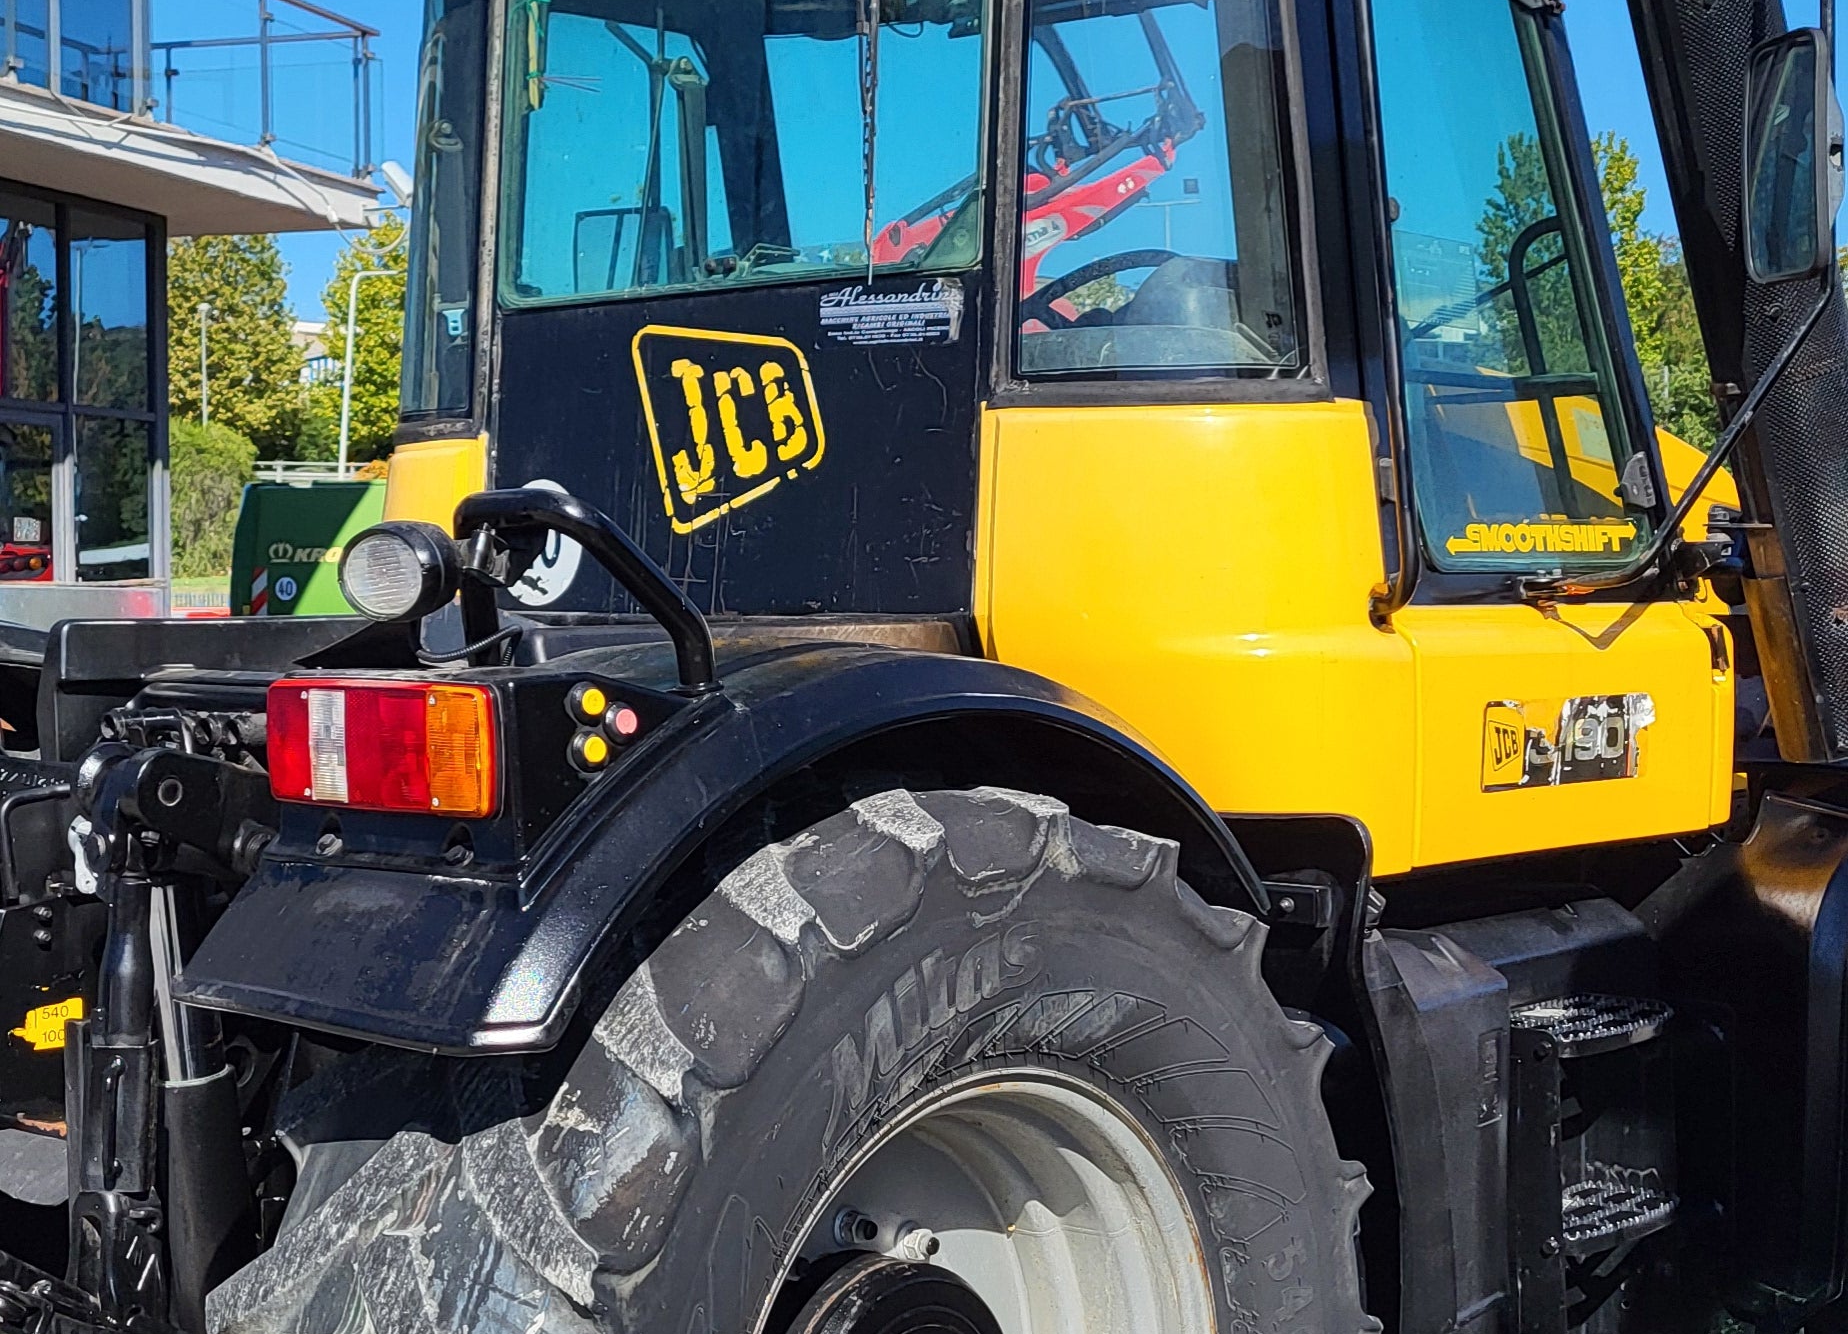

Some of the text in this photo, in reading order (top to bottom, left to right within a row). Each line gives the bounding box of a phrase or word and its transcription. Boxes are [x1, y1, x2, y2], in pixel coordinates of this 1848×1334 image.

[820, 282, 955, 306] Alessandrin
[860, 314, 897, 322] AGRICOLE
[671, 359, 807, 504] JCB
[1466, 523, 1626, 553] SMOOTHSHIFT
[293, 547, 343, 563] KRO
[278, 580, 294, 597] 40
[1493, 726, 1520, 766] JCB
[42, 1005, 69, 1020] 540
[42, 1028, 65, 1043] 100
[822, 920, 1043, 1149] Mitas
